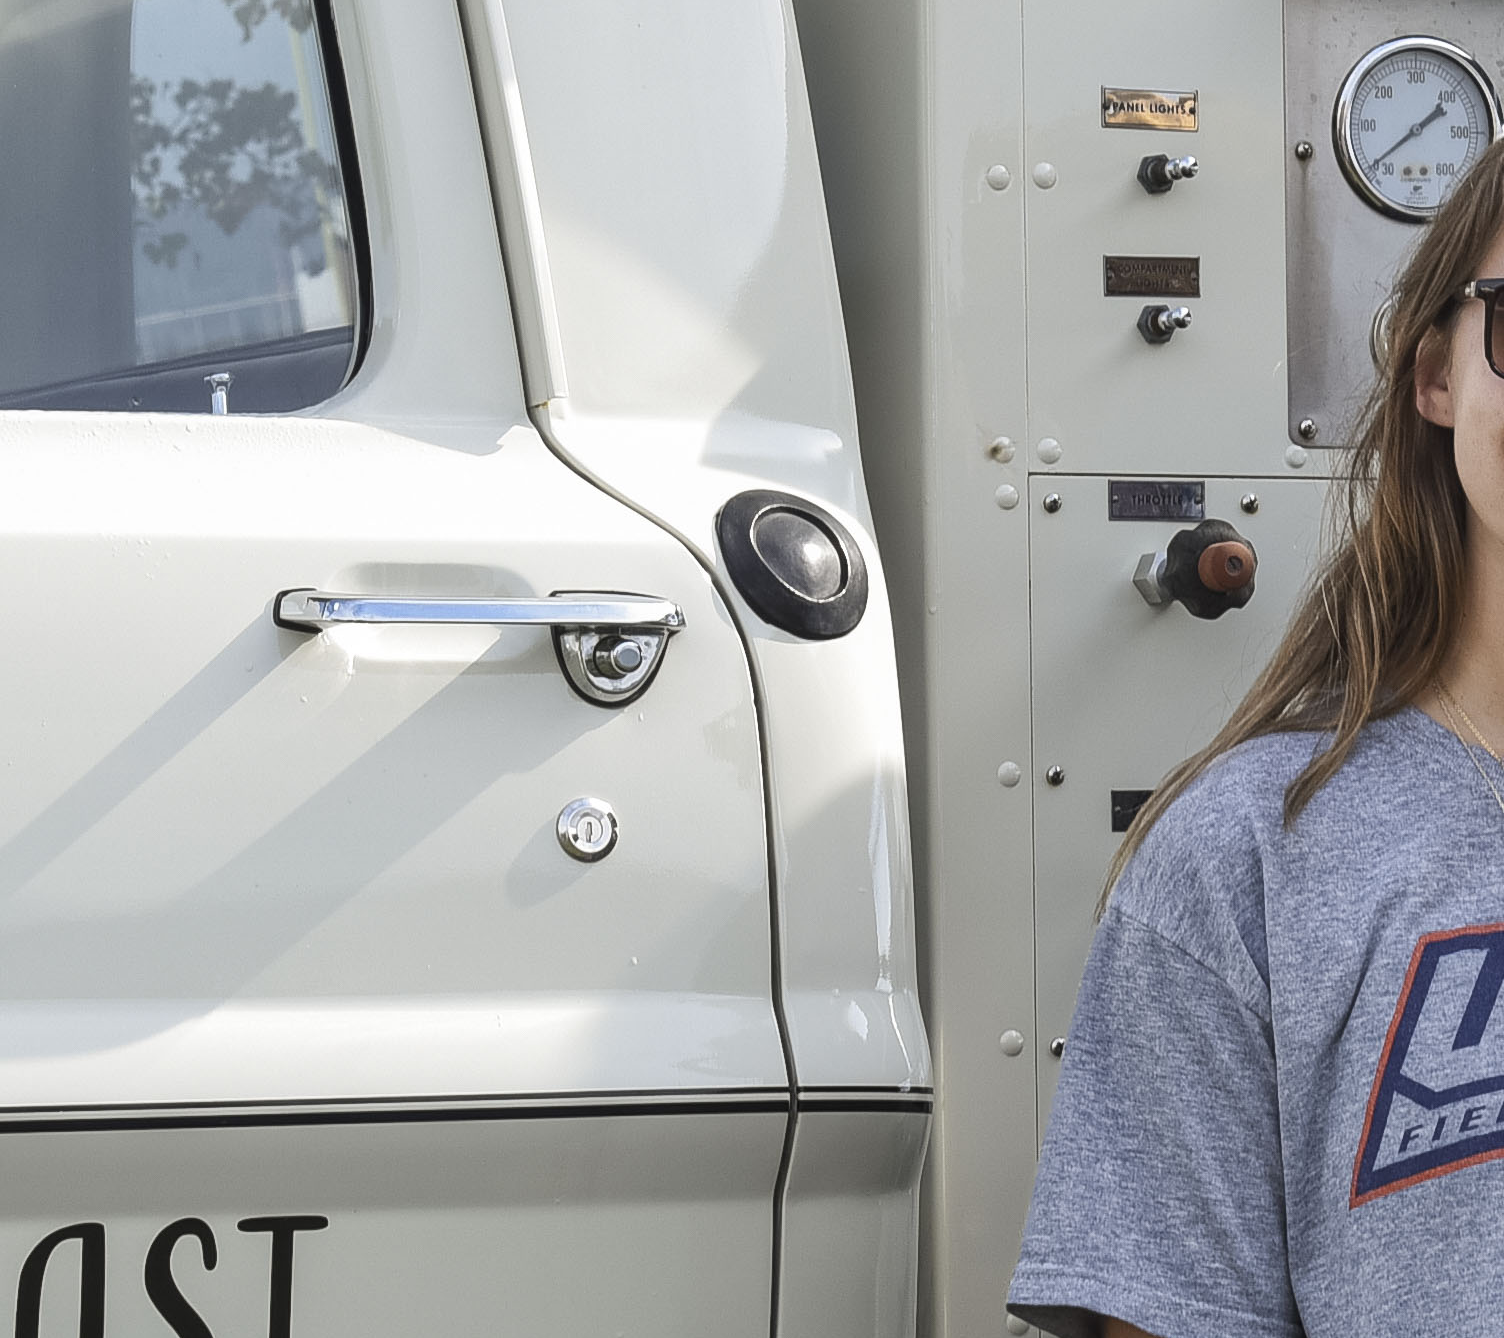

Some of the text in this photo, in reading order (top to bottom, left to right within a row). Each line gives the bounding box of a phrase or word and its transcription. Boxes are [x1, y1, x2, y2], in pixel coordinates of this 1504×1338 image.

[1406, 71, 1425, 84] 300
[1374, 85, 1393, 99] 200
[1437, 90, 1456, 103] 400
[1112, 101, 1186, 115] PANEL LIGHTS
[1360, 119, 1376, 132] 100
[1450, 126, 1469, 139] 500
[1381, 163, 1394, 176] 30
[1436, 163, 1455, 176] 600
